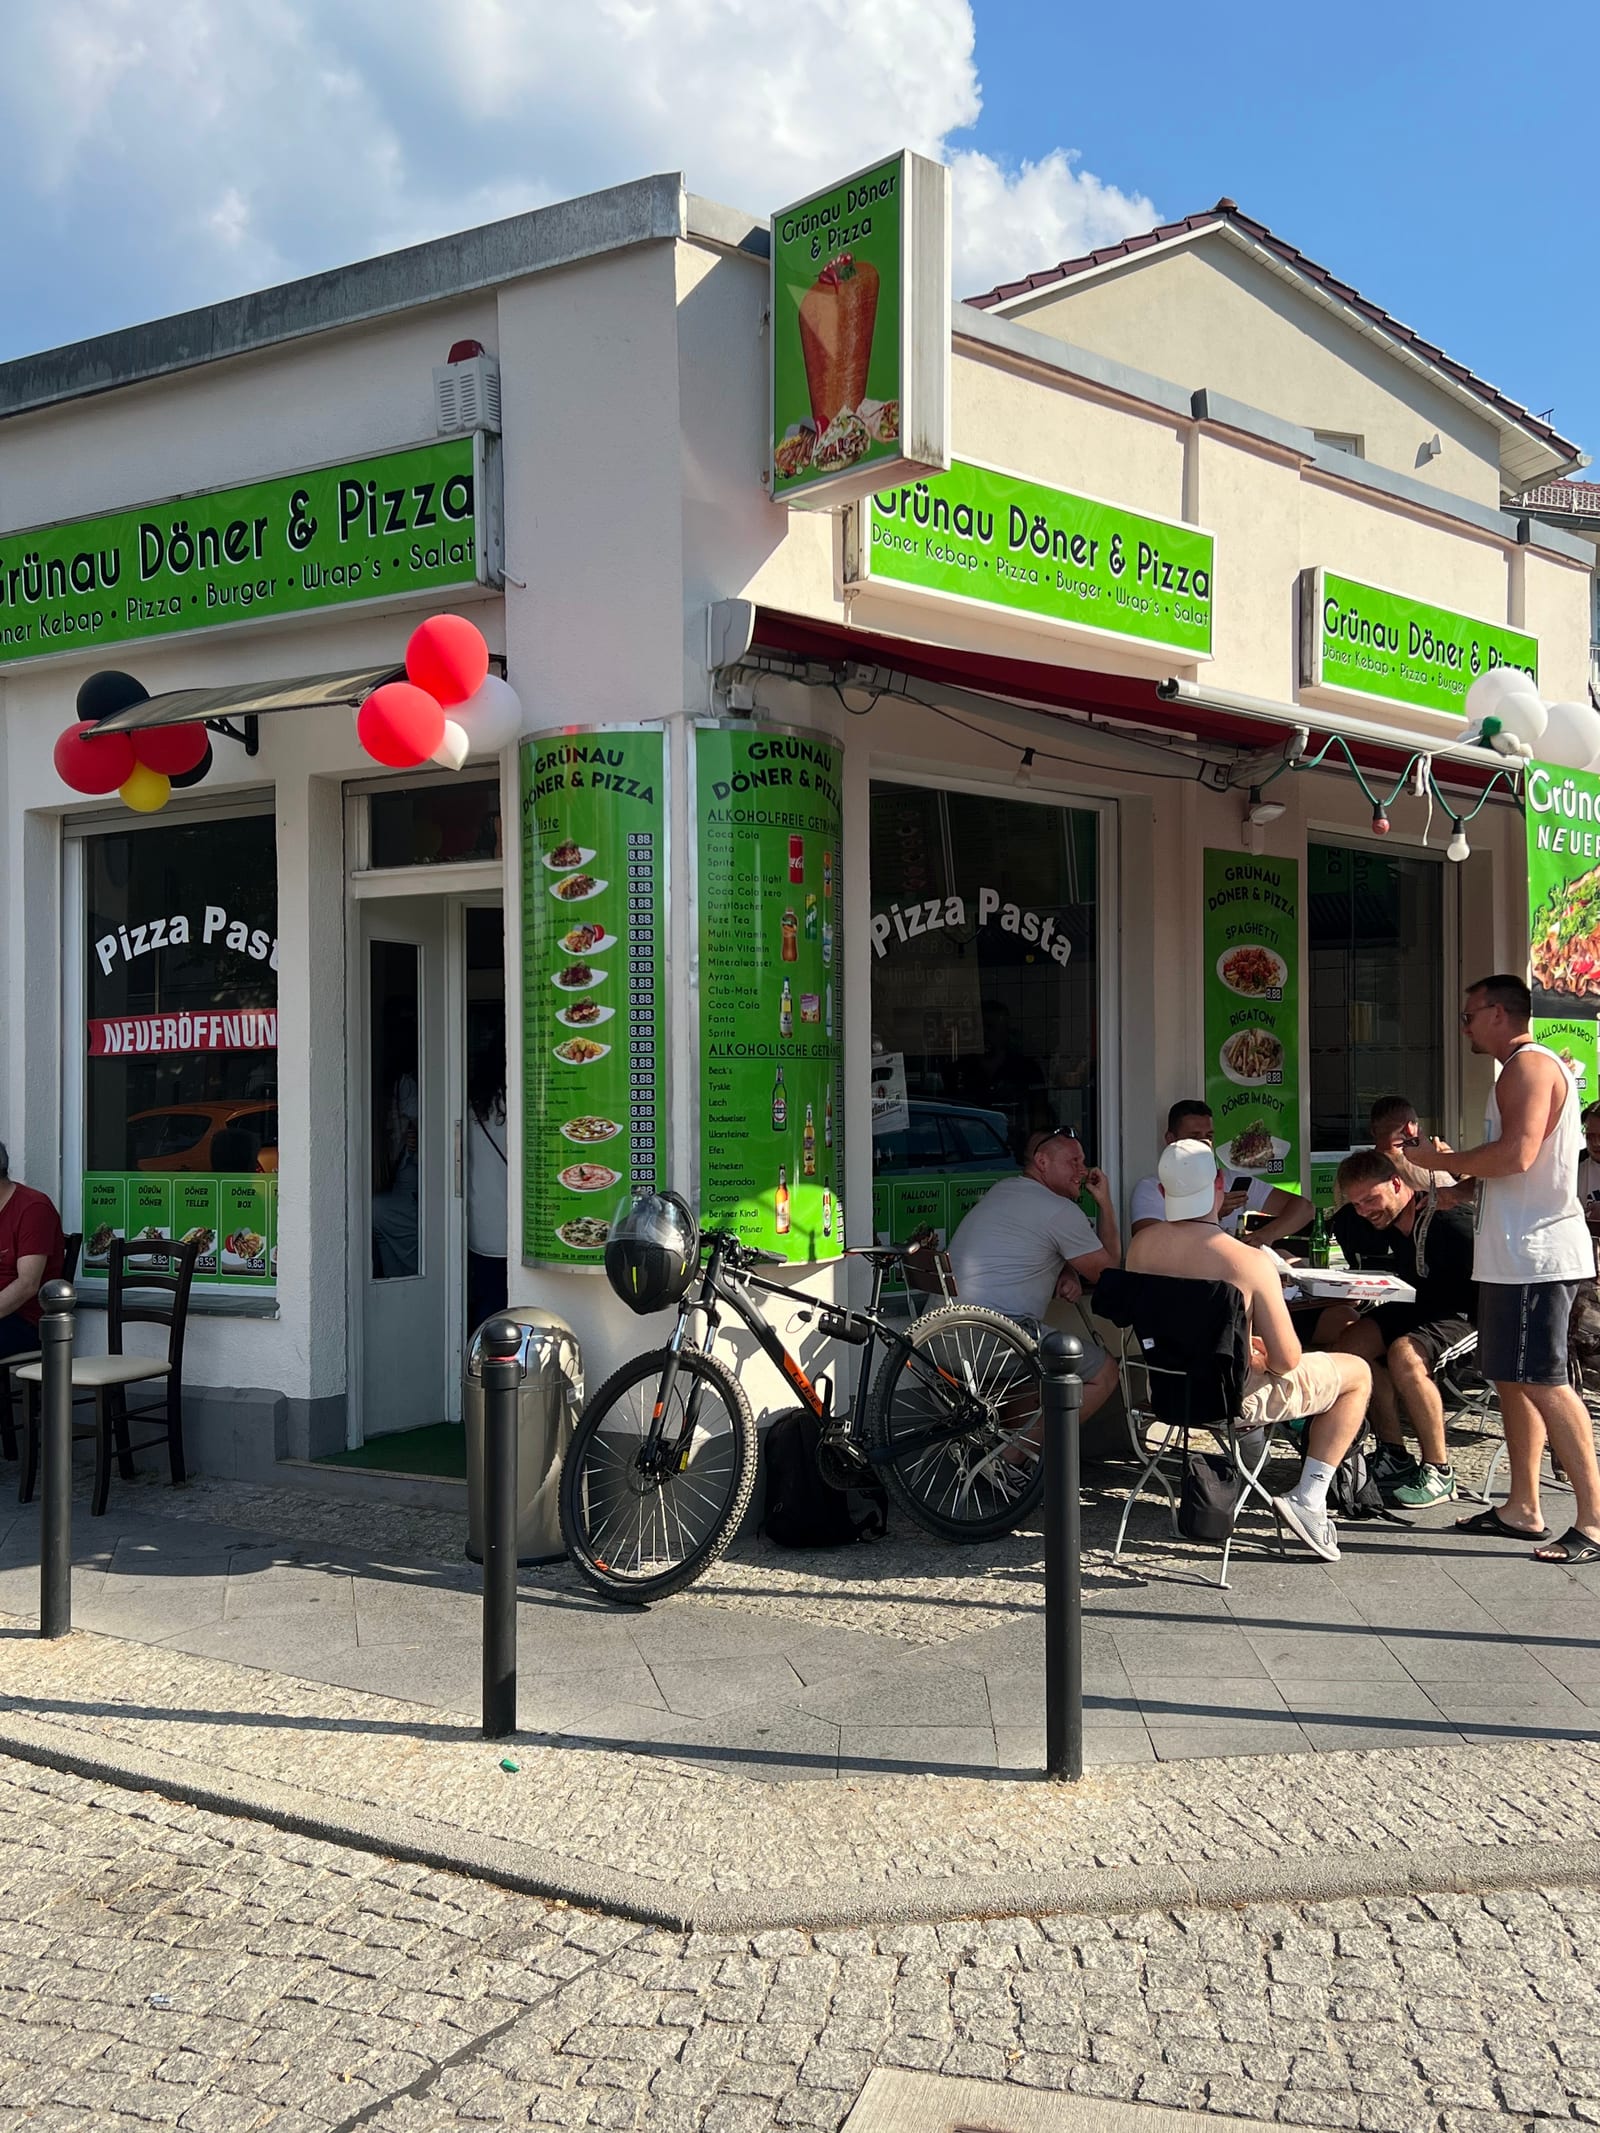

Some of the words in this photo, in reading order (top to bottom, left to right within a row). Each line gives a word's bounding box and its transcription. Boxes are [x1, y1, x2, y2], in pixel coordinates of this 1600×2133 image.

[781, 203, 841, 245] Grünau
[847, 175, 896, 217] Döner
[810, 235, 822, 260] &
[828, 216, 873, 247] Pizza
[139, 515, 269, 582] Döner
[286, 489, 317, 552] &
[338, 474, 474, 544] Pizza
[1009, 505, 1100, 568] Döner
[1109, 533, 1126, 575] &
[1137, 541, 1209, 600] Pizza
[872, 523, 919, 554] Döner
[925, 538, 978, 571] Kebap
[996, 557, 1039, 584] Pizza
[1056, 571, 1101, 600] Burger
[1174, 603, 1209, 627] Salat
[0, 622, 32, 646] ner
[38, 609, 104, 639] Kebap
[126, 593, 182, 623] Pizza
[206, 576, 277, 609] Burger
[408, 536, 474, 571] Salat
[1323, 598, 1399, 654] Grünau
[1409, 621, 1464, 671] Döner
[1471, 640, 1481, 674] &
[1323, 642, 1351, 664] Döner
[1355, 651, 1389, 676] Kebap
[1400, 663, 1428, 683] Pizza
[1438, 673, 1466, 695] Burger
[535, 745, 624, 774] GRÜNAU
[748, 737, 832, 772] GRÜNAU
[571, 771, 584, 787] &
[592, 772, 653, 805] PIZZA
[712, 768, 793, 800] DÖNER
[799, 769, 810, 788] &
[1528, 768, 1600, 823] Grün
[708, 809, 804, 826] ALKOHOLFREIE
[708, 830, 734, 838] Coca
[738, 830, 760, 839] Cola
[708, 844, 734, 853] Fanta
[708, 858, 735, 867] Sprite
[708, 873, 734, 882] Coca
[739, 873, 760, 882] Cola
[763, 874, 782, 884] light
[1225, 864, 1281, 887] GRÜNAU
[708, 887, 734, 896] Coca
[739, 887, 760, 897] Cola
[1208, 886, 1249, 912] DÖNER
[1252, 887, 1260, 900] &
[1264, 890, 1295, 919] PIZZA
[708, 916, 730, 925] Fuze
[733, 916, 750, 925] Tea
[871, 896, 966, 959] Pizza
[979, 887, 1072, 967] Pasta
[708, 930, 731, 938] Multi
[734, 930, 767, 939] Vitamin
[1225, 921, 1279, 944] SPAGHETTI
[95, 914, 190, 976] Pizza
[203, 905, 278, 972] Past
[708, 944, 734, 953] Rubin
[737, 944, 770, 953] Vitamin
[708, 958, 772, 968] Mineralwasser
[708, 973, 735, 981] Ayran
[708, 986, 759, 996] Club-Mate
[708, 1001, 735, 1010] Coca
[738, 1001, 760, 1010] Cola
[708, 1015, 735, 1024] Fanta
[1229, 1008, 1276, 1028] RIGATONI
[103, 1012, 278, 1053] NEUERÖFFNUN
[708, 1029, 736, 1038] Sprite
[1536, 1023, 1568, 1044] HALLOUMI
[1577, 1027, 1594, 1045] BROT
[708, 1043, 808, 1057] ALKOHOLISCHE
[708, 1098, 728, 1107] Lech
[1221, 1093, 1249, 1116] DÖNER
[1262, 1094, 1284, 1114] BROT
[708, 1114, 746, 1123] Budweiser
[708, 1130, 750, 1139] Warsteiner
[708, 1146, 725, 1154] Efes
[708, 1162, 744, 1171] Heineken
[708, 1177, 756, 1187] Desperados
[93, 1184, 115, 1194] DÖNER
[184, 1186, 208, 1196] DÖNER
[231, 1187, 256, 1197] DÖNER
[708, 1194, 740, 1203] Corona
[901, 1190, 940, 1201] HALLOUMI
[139, 1196, 162, 1206] DÖNER
[185, 1199, 209, 1208] TELLER
[708, 1209, 737, 1218] Berliner
[739, 1209, 759, 1217] Kindl
[917, 1204, 938, 1214] BROT
[739, 1225, 763, 1234] Pilsner
[793, 1372, 821, 1408] CUBE
